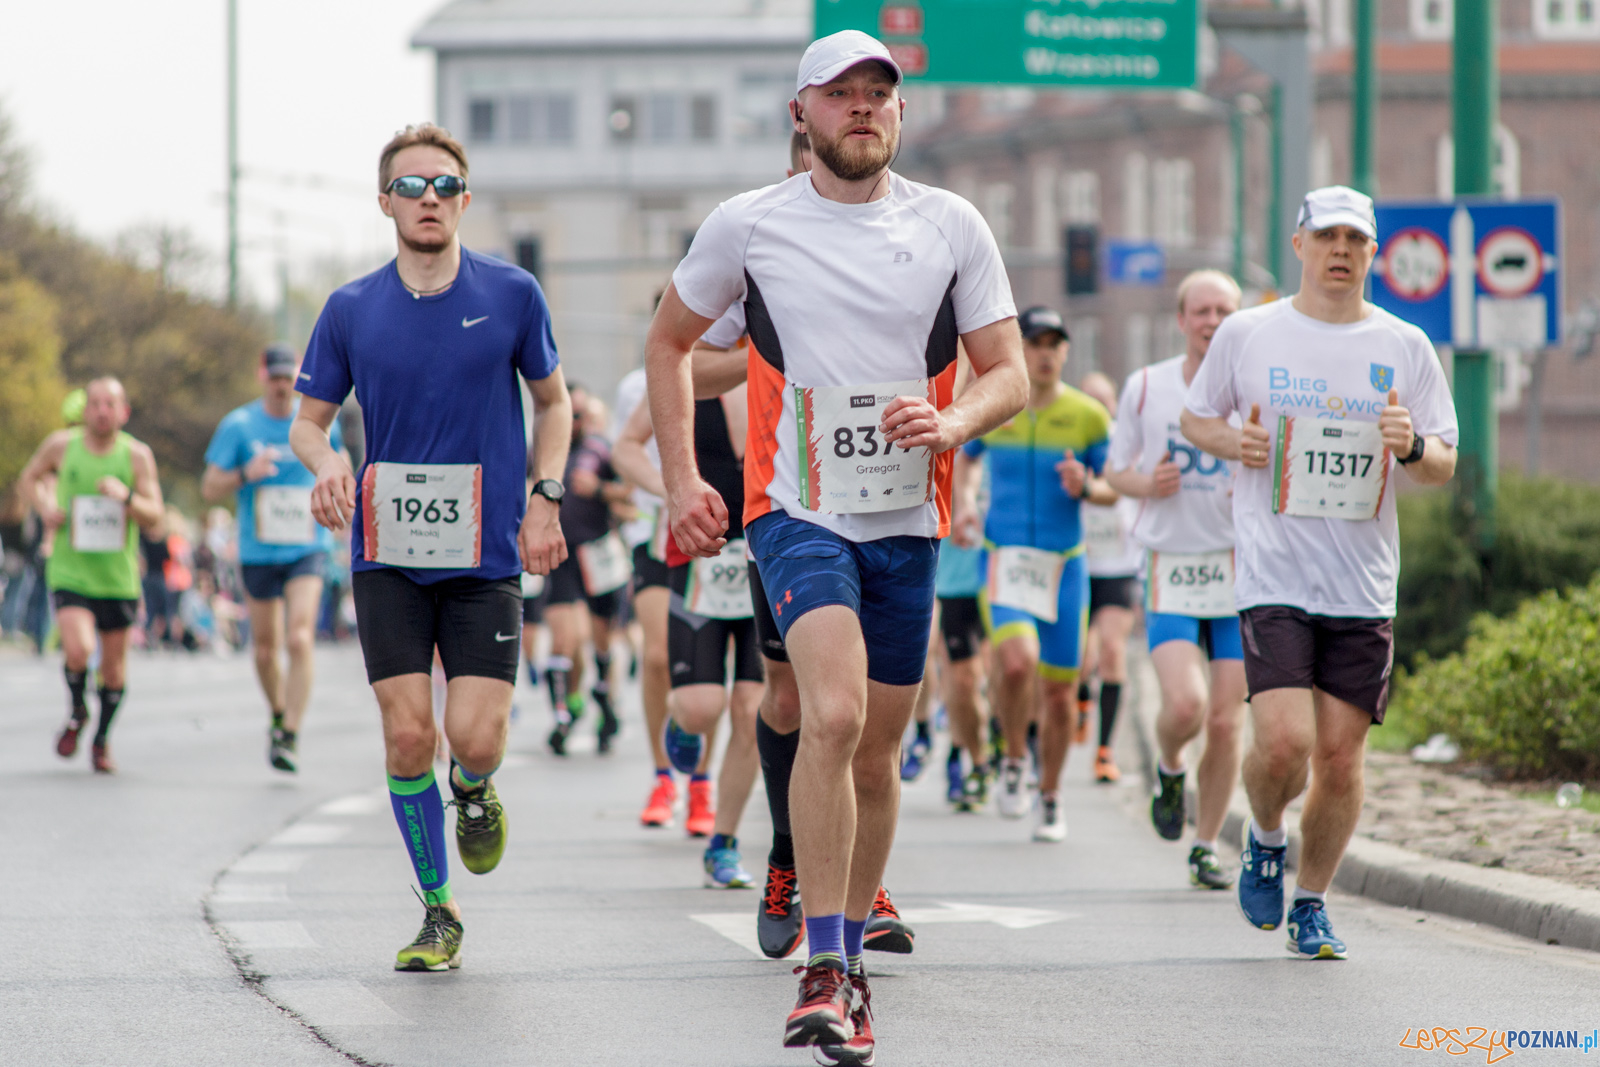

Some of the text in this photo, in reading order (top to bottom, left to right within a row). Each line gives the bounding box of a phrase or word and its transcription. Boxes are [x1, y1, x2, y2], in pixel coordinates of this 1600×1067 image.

[1024, 9, 1167, 41] Katowice
[834, 425, 912, 459] 837
[856, 464, 901, 474] Grzegorz
[1305, 450, 1374, 478] 11317
[1328, 481, 1346, 490] Piotr
[392, 497, 459, 524] 1963
[1169, 564, 1225, 586] 6354
